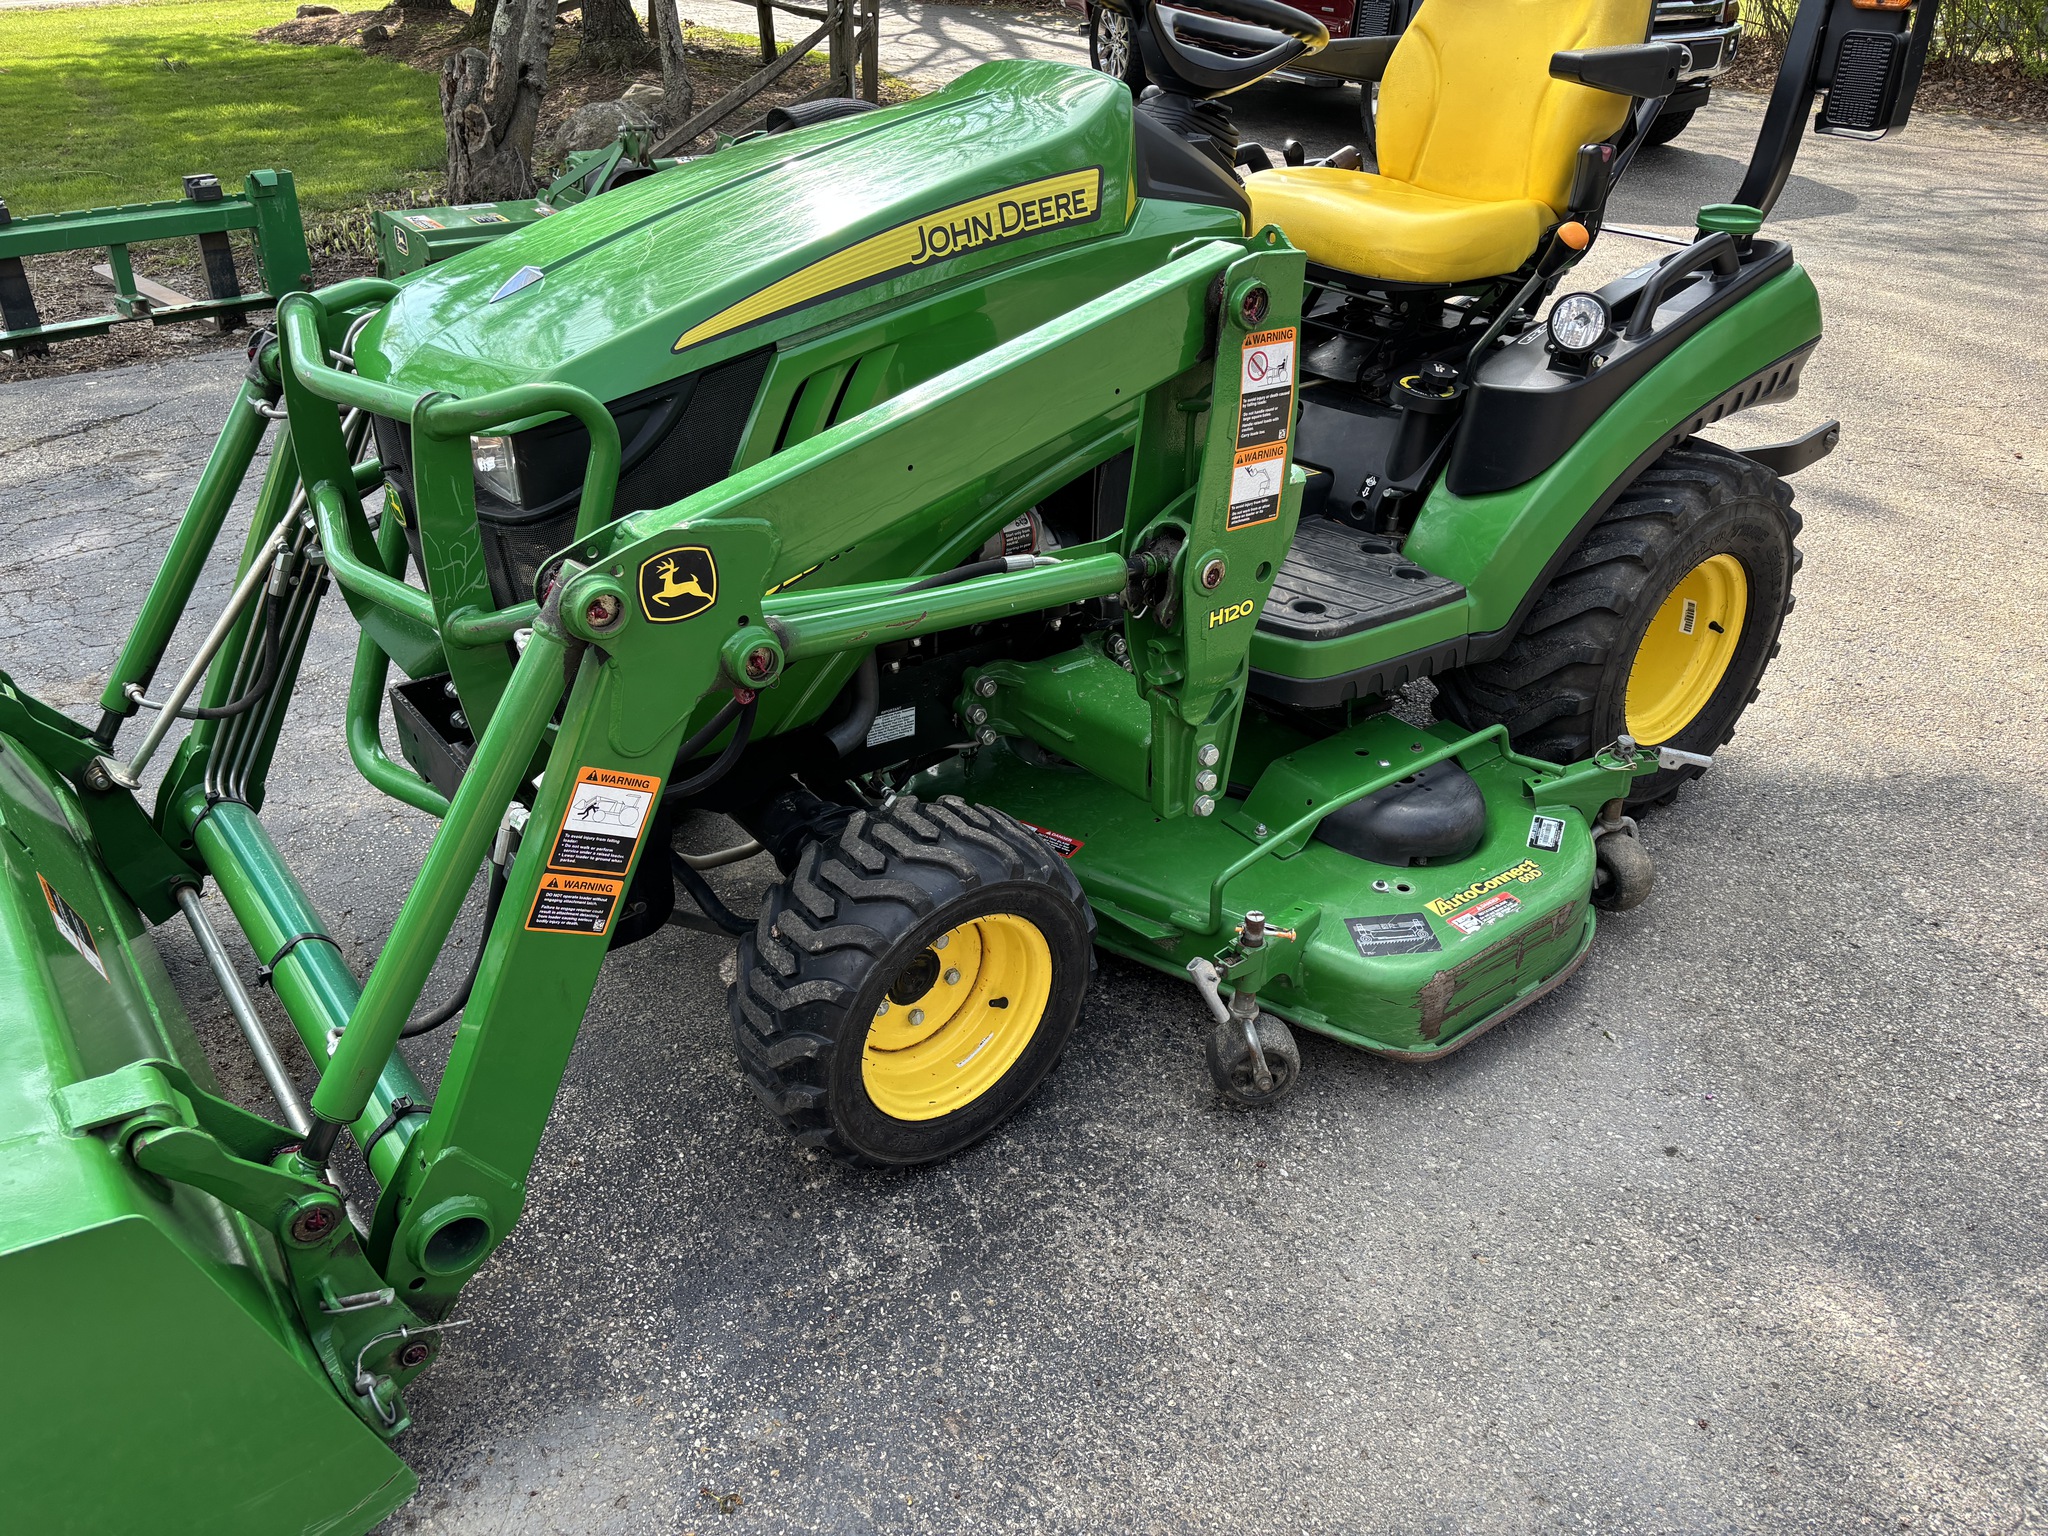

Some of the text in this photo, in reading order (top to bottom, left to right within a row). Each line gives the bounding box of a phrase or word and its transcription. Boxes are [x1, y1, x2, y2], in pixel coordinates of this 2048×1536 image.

[912, 189, 1088, 261] JOHN DEERE
[1253, 330, 1292, 344] WARNING
[1245, 446, 1283, 462] WARNING
[1209, 599, 1254, 629] H120
[601, 774, 650, 788] WARNING
[1518, 869, 1542, 883] 60D
[564, 880, 613, 892] WARNING
[1435, 859, 1539, 915] AutoConnect
